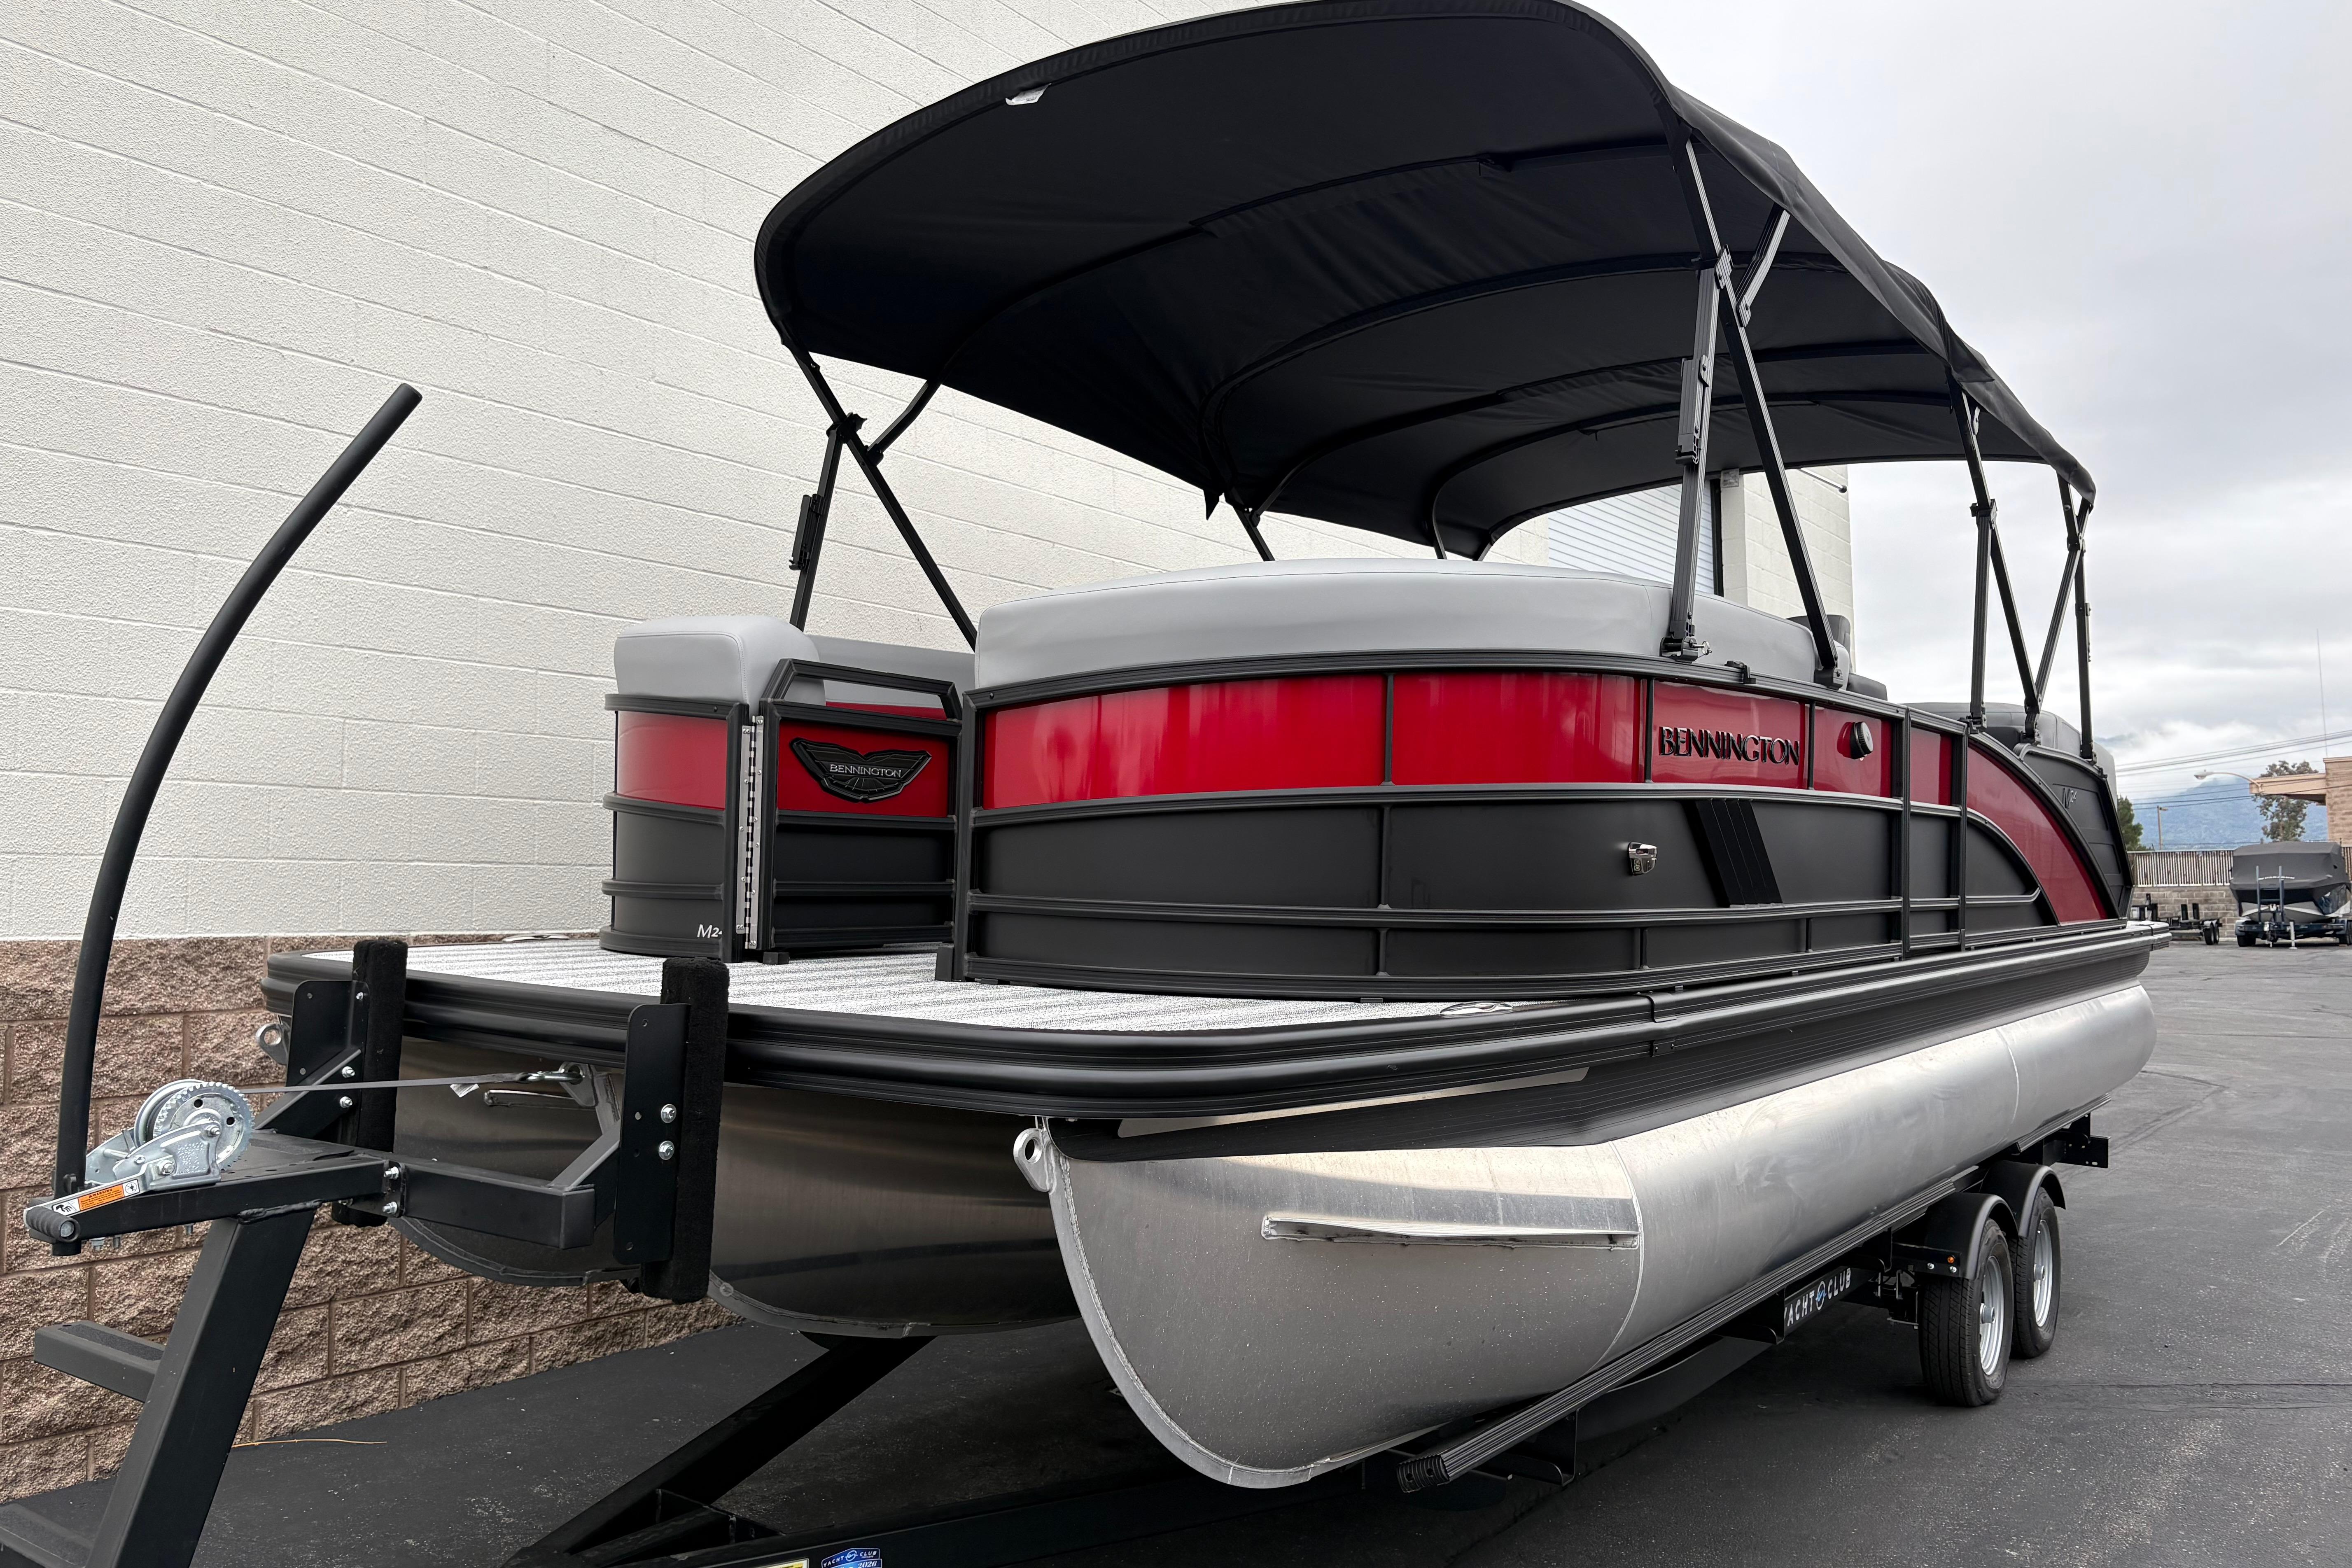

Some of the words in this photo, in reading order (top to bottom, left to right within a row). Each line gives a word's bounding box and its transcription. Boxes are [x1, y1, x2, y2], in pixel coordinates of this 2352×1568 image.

[1658, 726, 1800, 765] BENNINGTON
[829, 764, 901, 777] BENNINGTON
[1827, 1267, 1851, 1299] CLUB
[824, 1556, 844, 1567] YACHT
